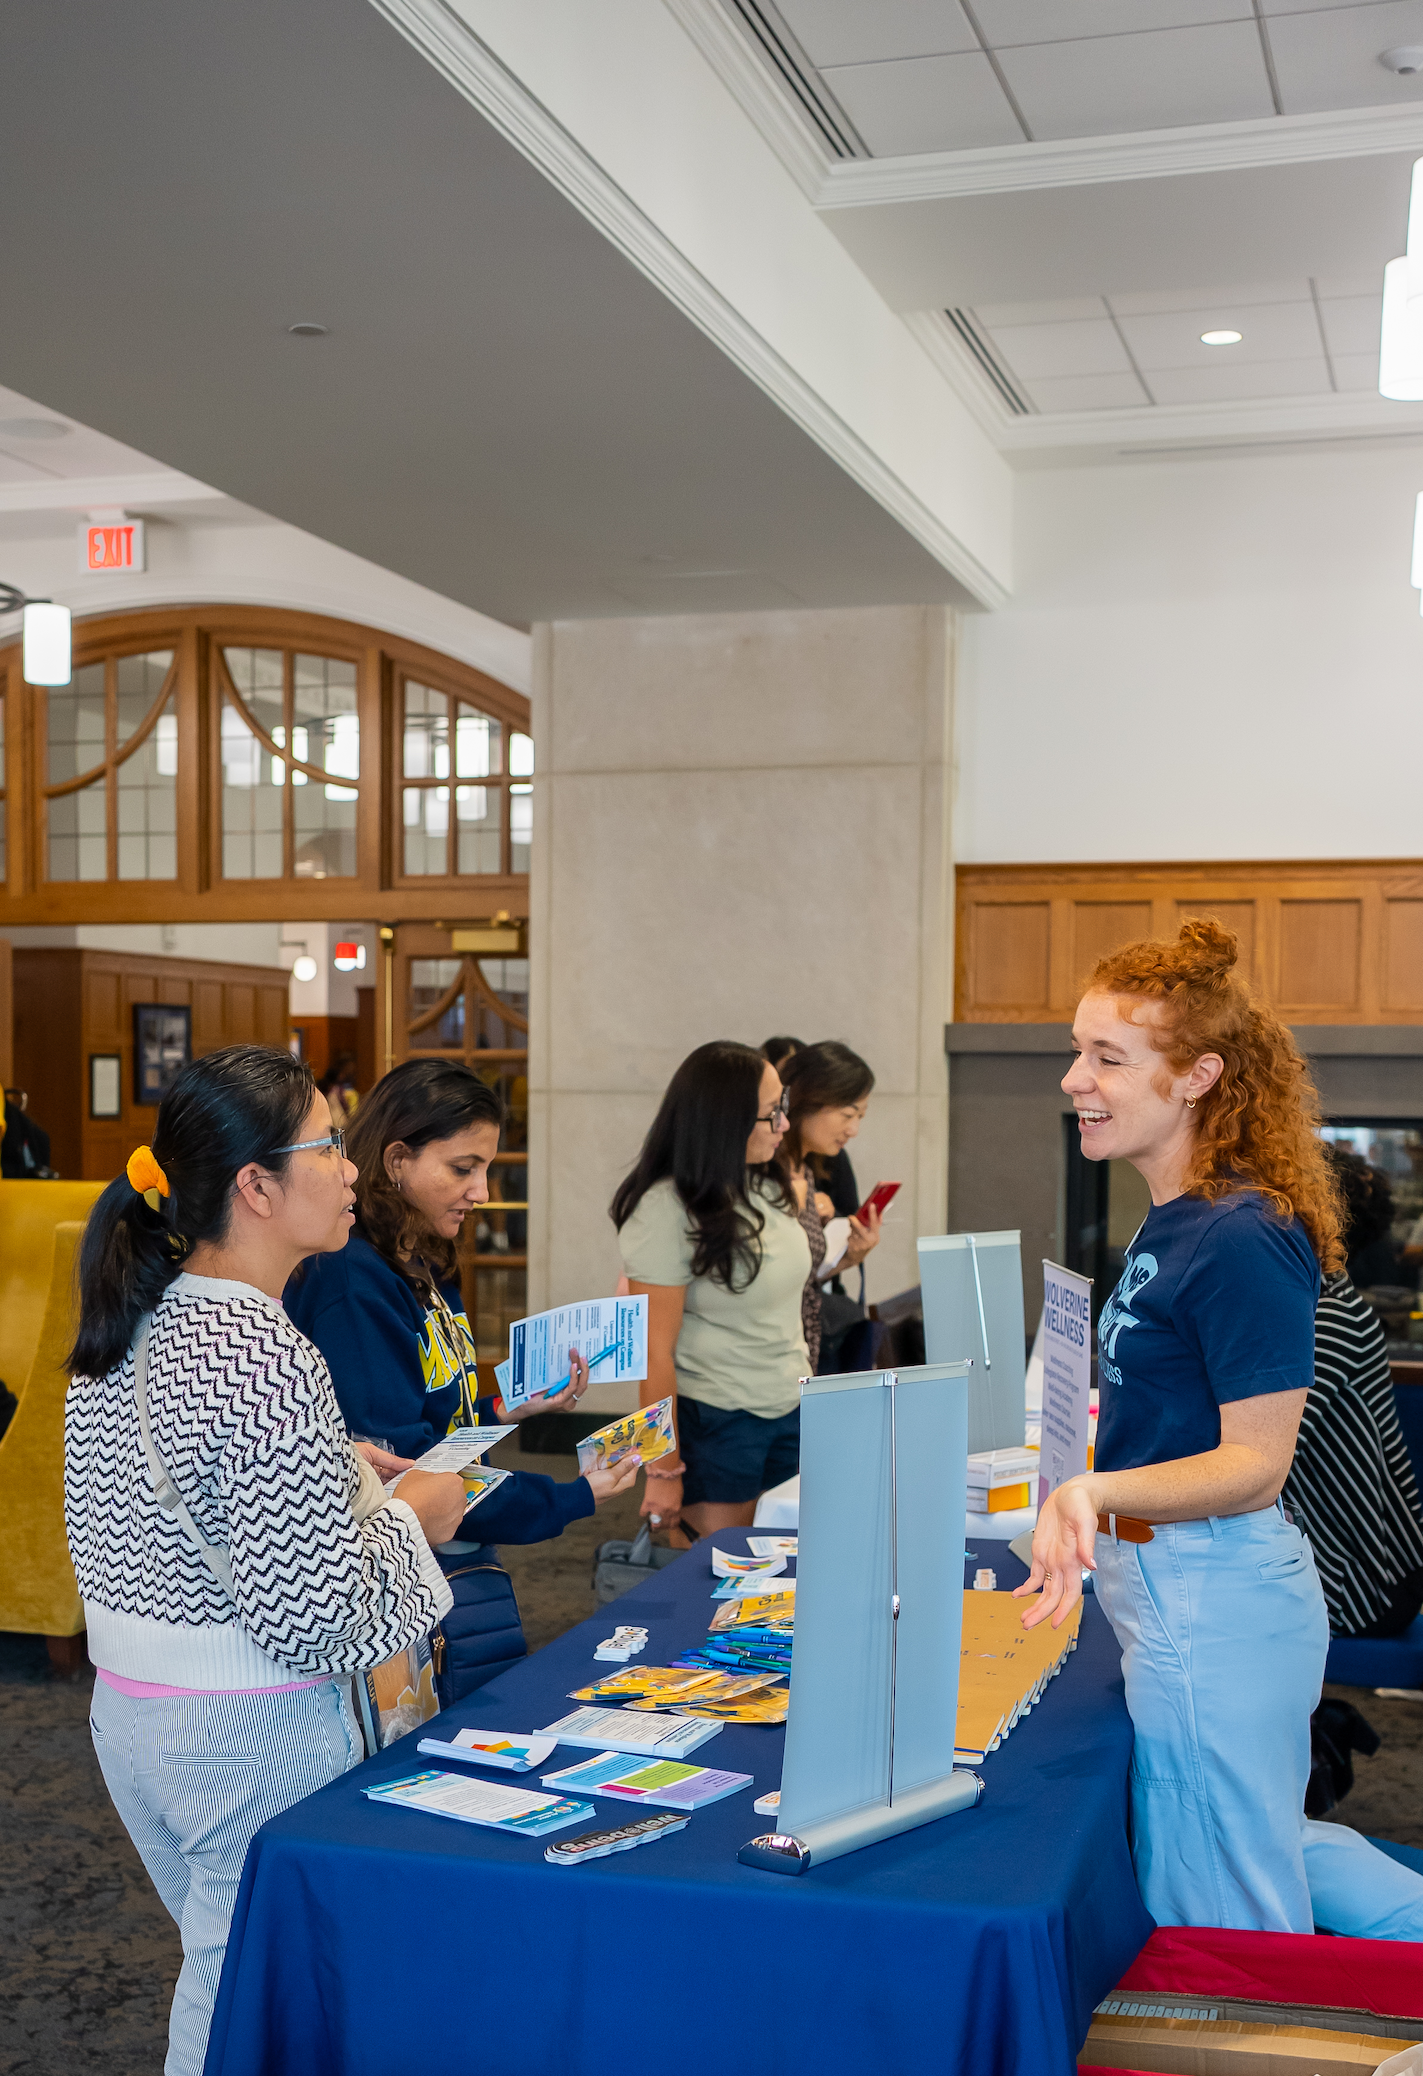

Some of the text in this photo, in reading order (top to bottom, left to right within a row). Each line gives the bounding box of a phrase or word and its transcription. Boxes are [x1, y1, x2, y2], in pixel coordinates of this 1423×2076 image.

[87, 526, 135, 569] EXIT
[1045, 1281, 1088, 1321] WOLVERINE
[1045, 1306, 1084, 1347] WELLNESS
[366, 1673, 378, 1705] BLUE
[560, 1814, 682, 1853] well being
